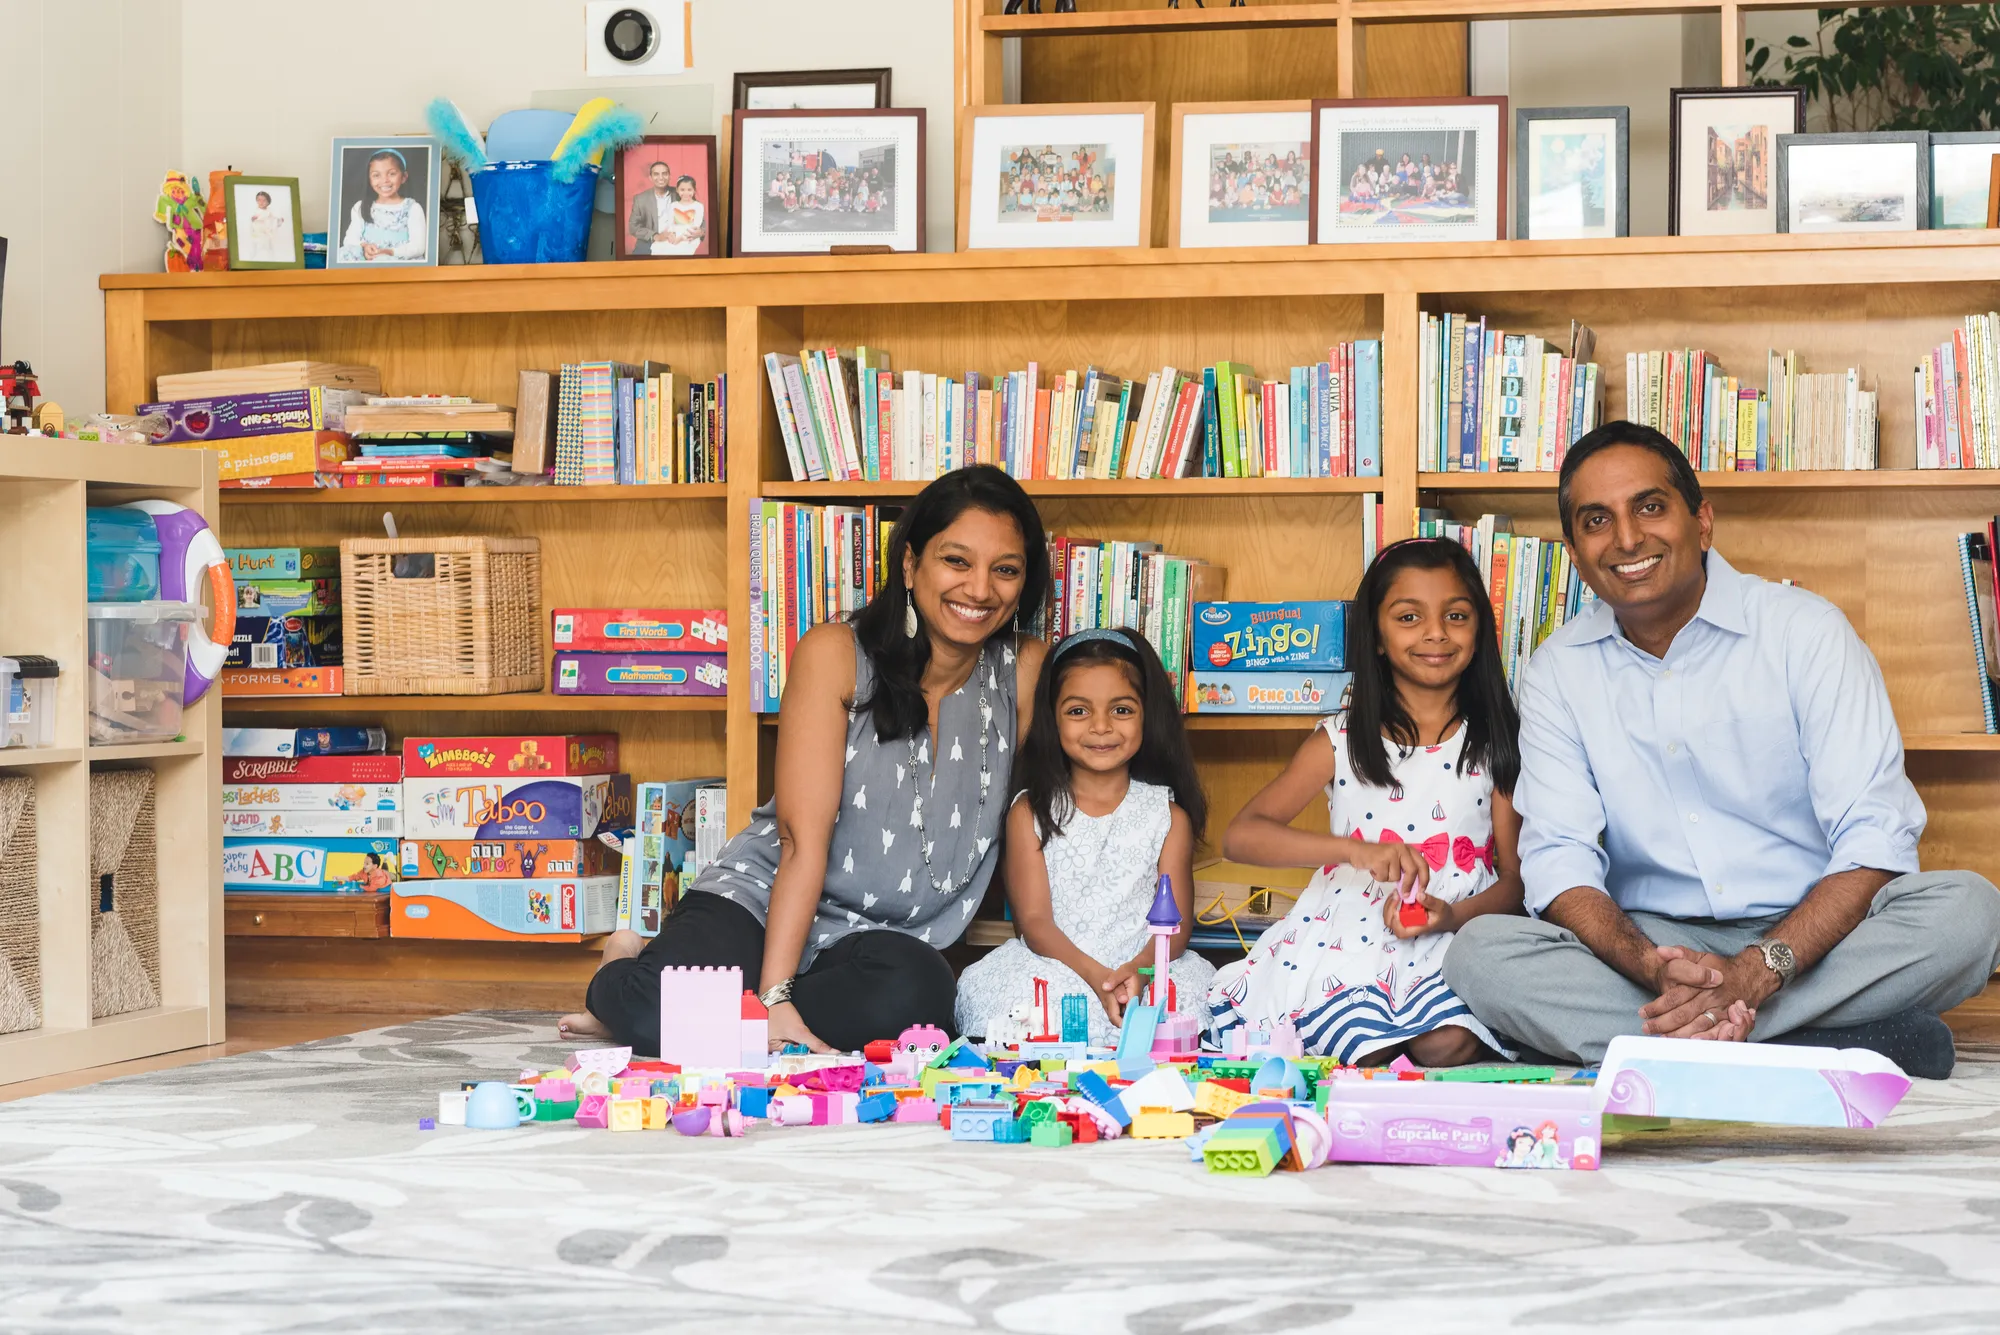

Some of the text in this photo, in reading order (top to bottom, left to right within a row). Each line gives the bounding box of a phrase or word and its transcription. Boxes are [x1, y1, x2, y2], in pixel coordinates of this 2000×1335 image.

[1452, 327, 1464, 342] Up
[1451, 363, 1462, 395] Away
[788, 370, 805, 426] Find the Kitten
[1947, 386, 1958, 424] Clifford's
[1145, 384, 1170, 460] Your Personal Penguin
[1320, 389, 1329, 451] BARNYARD DANCE!
[388, 475, 426, 484] spirograph
[239, 554, 275, 570] Hunt
[786, 512, 794, 627] MY FIRST ENCYCLOPEDIA
[750, 513, 762, 670] BRAIN QUEST WORKBOOK
[1054, 579, 1063, 598] BIG
[1495, 577, 1505, 597] The
[1053, 602, 1062, 632] BOOK
[1167, 614, 1173, 623] Do
[1251, 608, 1301, 625] Bilingual
[619, 627, 668, 636] First Words
[1224, 623, 1320, 660] Zingo!
[1246, 657, 1270, 668] BINGO
[1290, 652, 1309, 661] ZING
[620, 672, 673, 681] Mathematics
[233, 760, 298, 779] SCRABBLE
[456, 784, 547, 828] Taboo
[597, 780, 630, 823] Taboo
[232, 814, 260, 824] LAND
[462, 856, 516, 875] Junior
[621, 860, 629, 914] Subtraction
[1387, 1126, 1490, 1145] Cupcake Party
